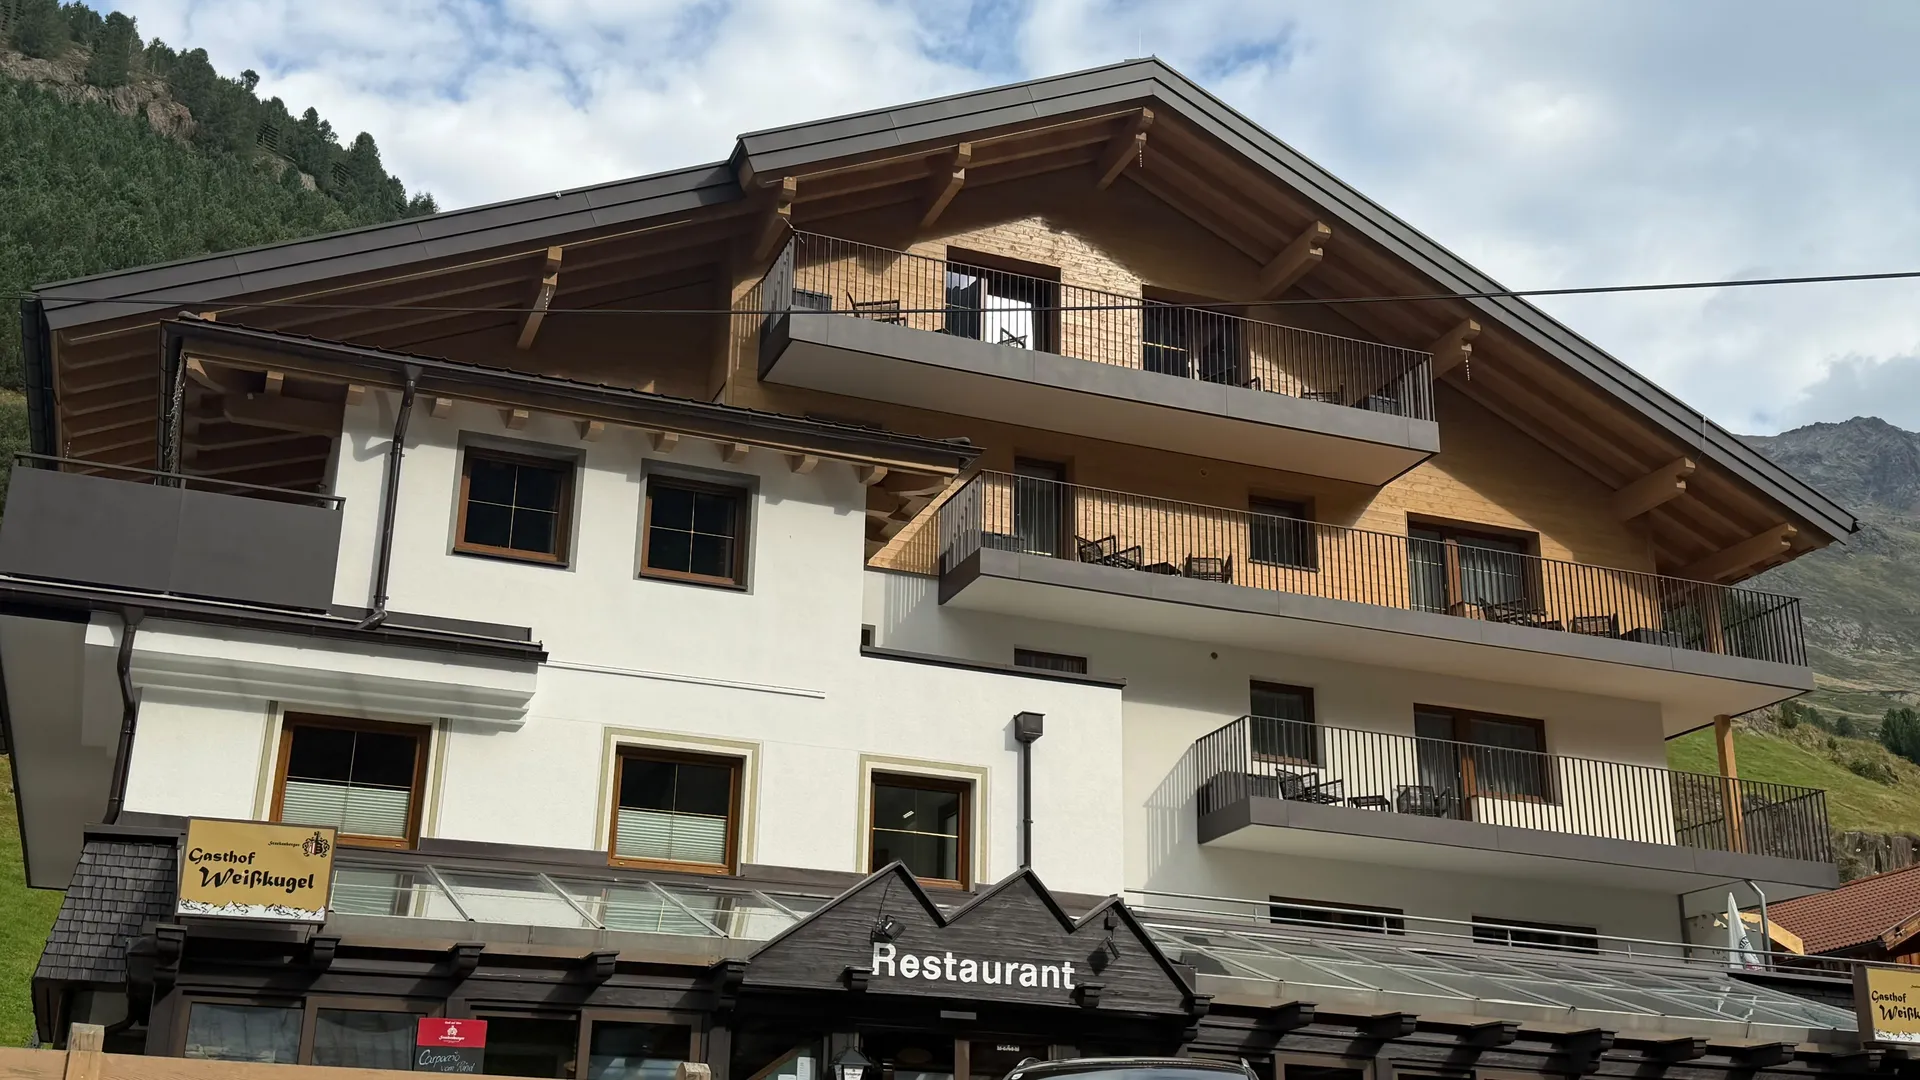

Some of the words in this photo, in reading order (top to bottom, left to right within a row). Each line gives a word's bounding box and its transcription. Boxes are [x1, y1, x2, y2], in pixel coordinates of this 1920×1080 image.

[188, 847, 256, 865] Gasthof
[199, 866, 314, 894] Weißkugel
[872, 942, 1076, 990] Restaurant
[1871, 990, 1907, 1003] Gasthof
